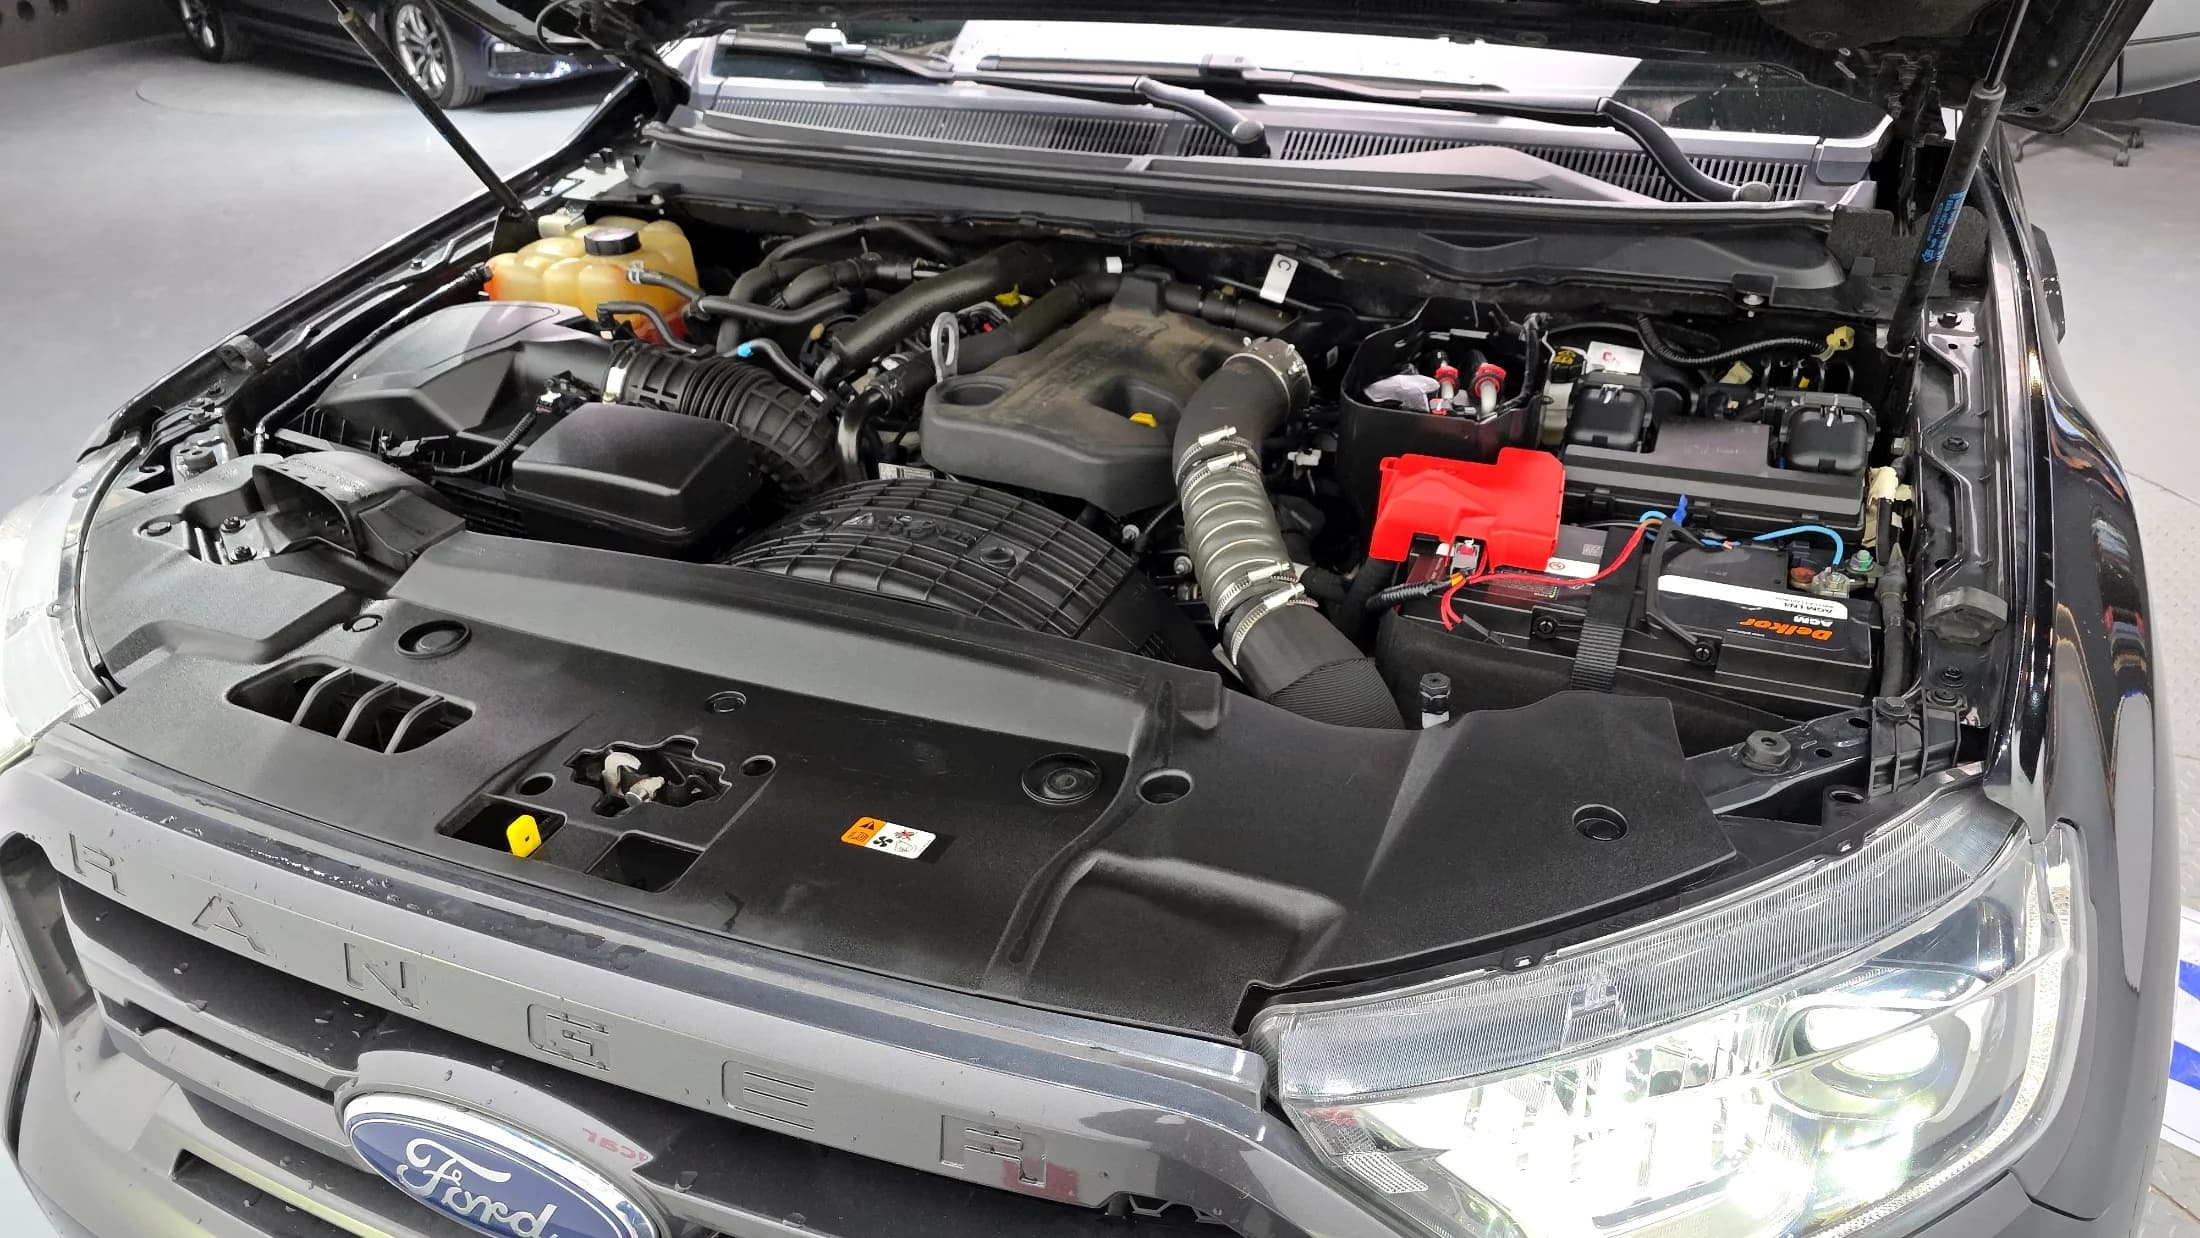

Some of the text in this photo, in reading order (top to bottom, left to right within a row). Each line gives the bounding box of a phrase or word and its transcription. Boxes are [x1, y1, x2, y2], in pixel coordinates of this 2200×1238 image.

[1737, 618, 1833, 641] Delkor
[1793, 614, 1833, 628] AGM
[68, 832, 1048, 1188] RANGER
[396, 1137, 557, 1238] Ford
